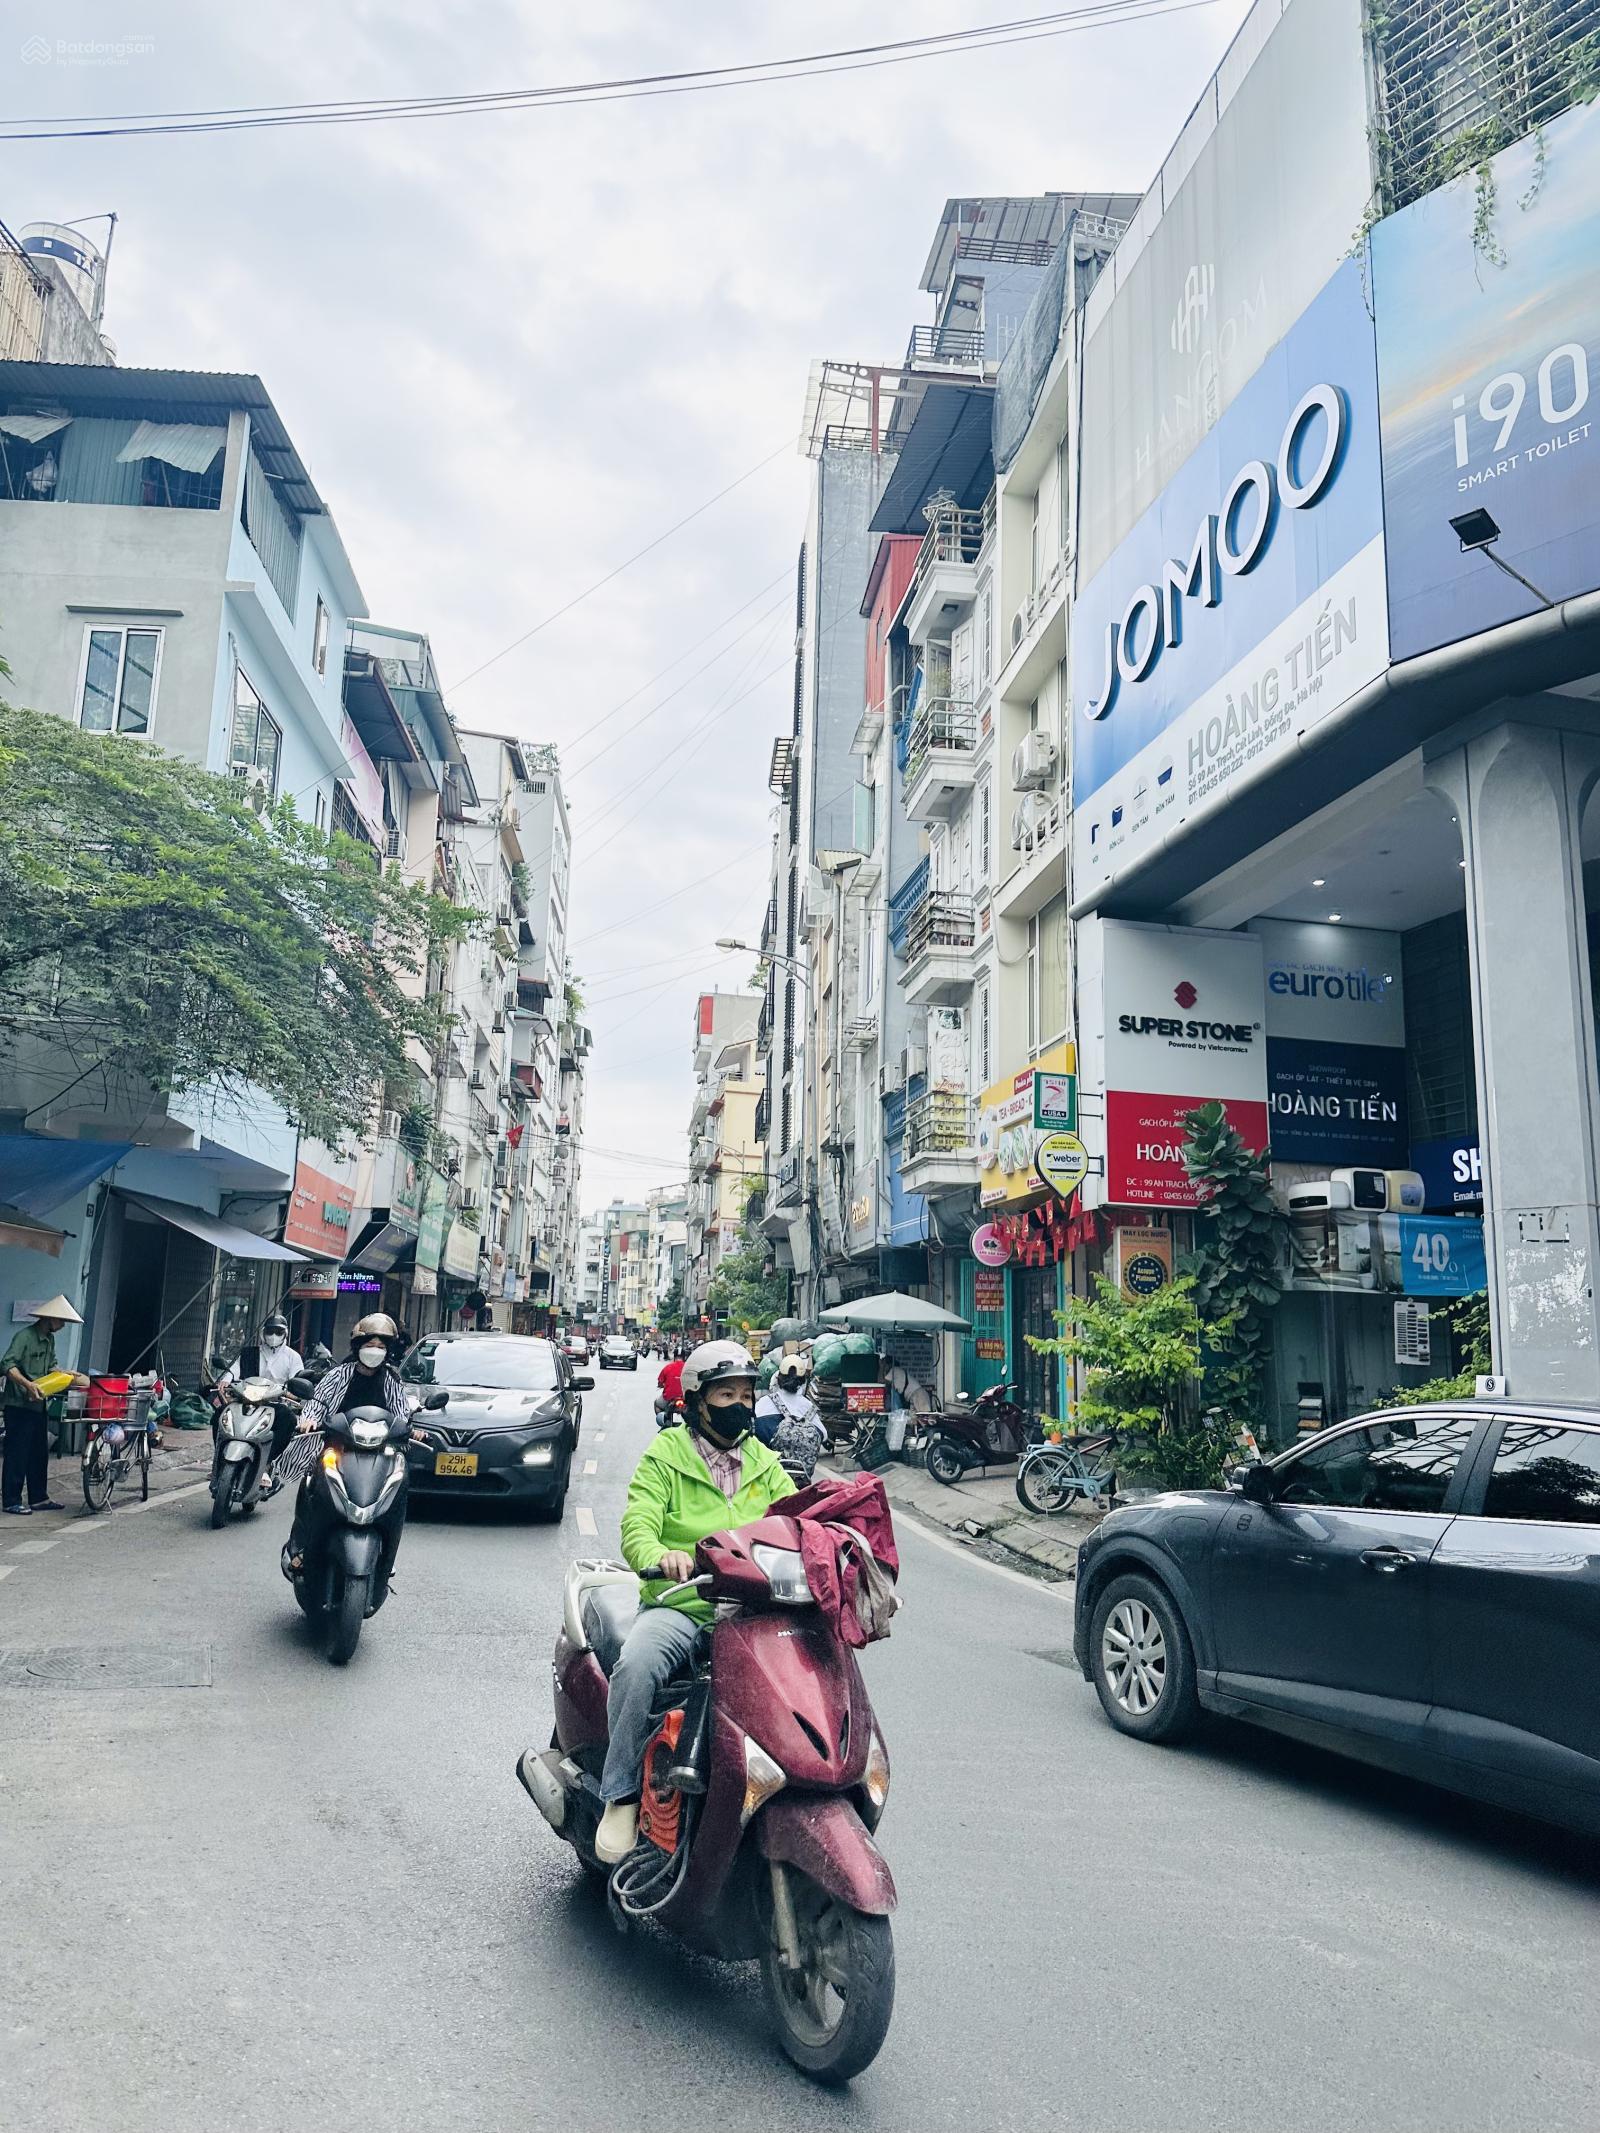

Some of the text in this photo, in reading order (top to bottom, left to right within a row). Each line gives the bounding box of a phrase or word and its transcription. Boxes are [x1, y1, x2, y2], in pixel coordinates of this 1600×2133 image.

[1452, 343, 1590, 469] i90
[1457, 422, 1592, 492] SMART TOILET
[1083, 384, 1349, 721] JOMOO
[1188, 596, 1357, 776] HOÀNG TIẾN
[1119, 1014, 1253, 1042] SUPER STONE
[1168, 1040, 1249, 1054] Powered by Vietceramics
[1267, 1089, 1398, 1122] HOÀNG TIẾN
[1047, 1110, 1063, 1118] USA
[1136, 1139, 1188, 1162] HOÀN
[1053, 1153, 1081, 1163] weber
[1144, 1178, 1153, 1187] 99
[1153, 1179, 1164, 1188] AN
[1126, 1189, 1154, 1198] HOTLINE
[1163, 1191, 1182, 1200] 02435
[1183, 1192, 1195, 1201] 650
[1453, 1190, 1475, 1202] Email:
[448, 1455, 466, 1464] 29H
[440, 1464, 473, 1475] 994.46
